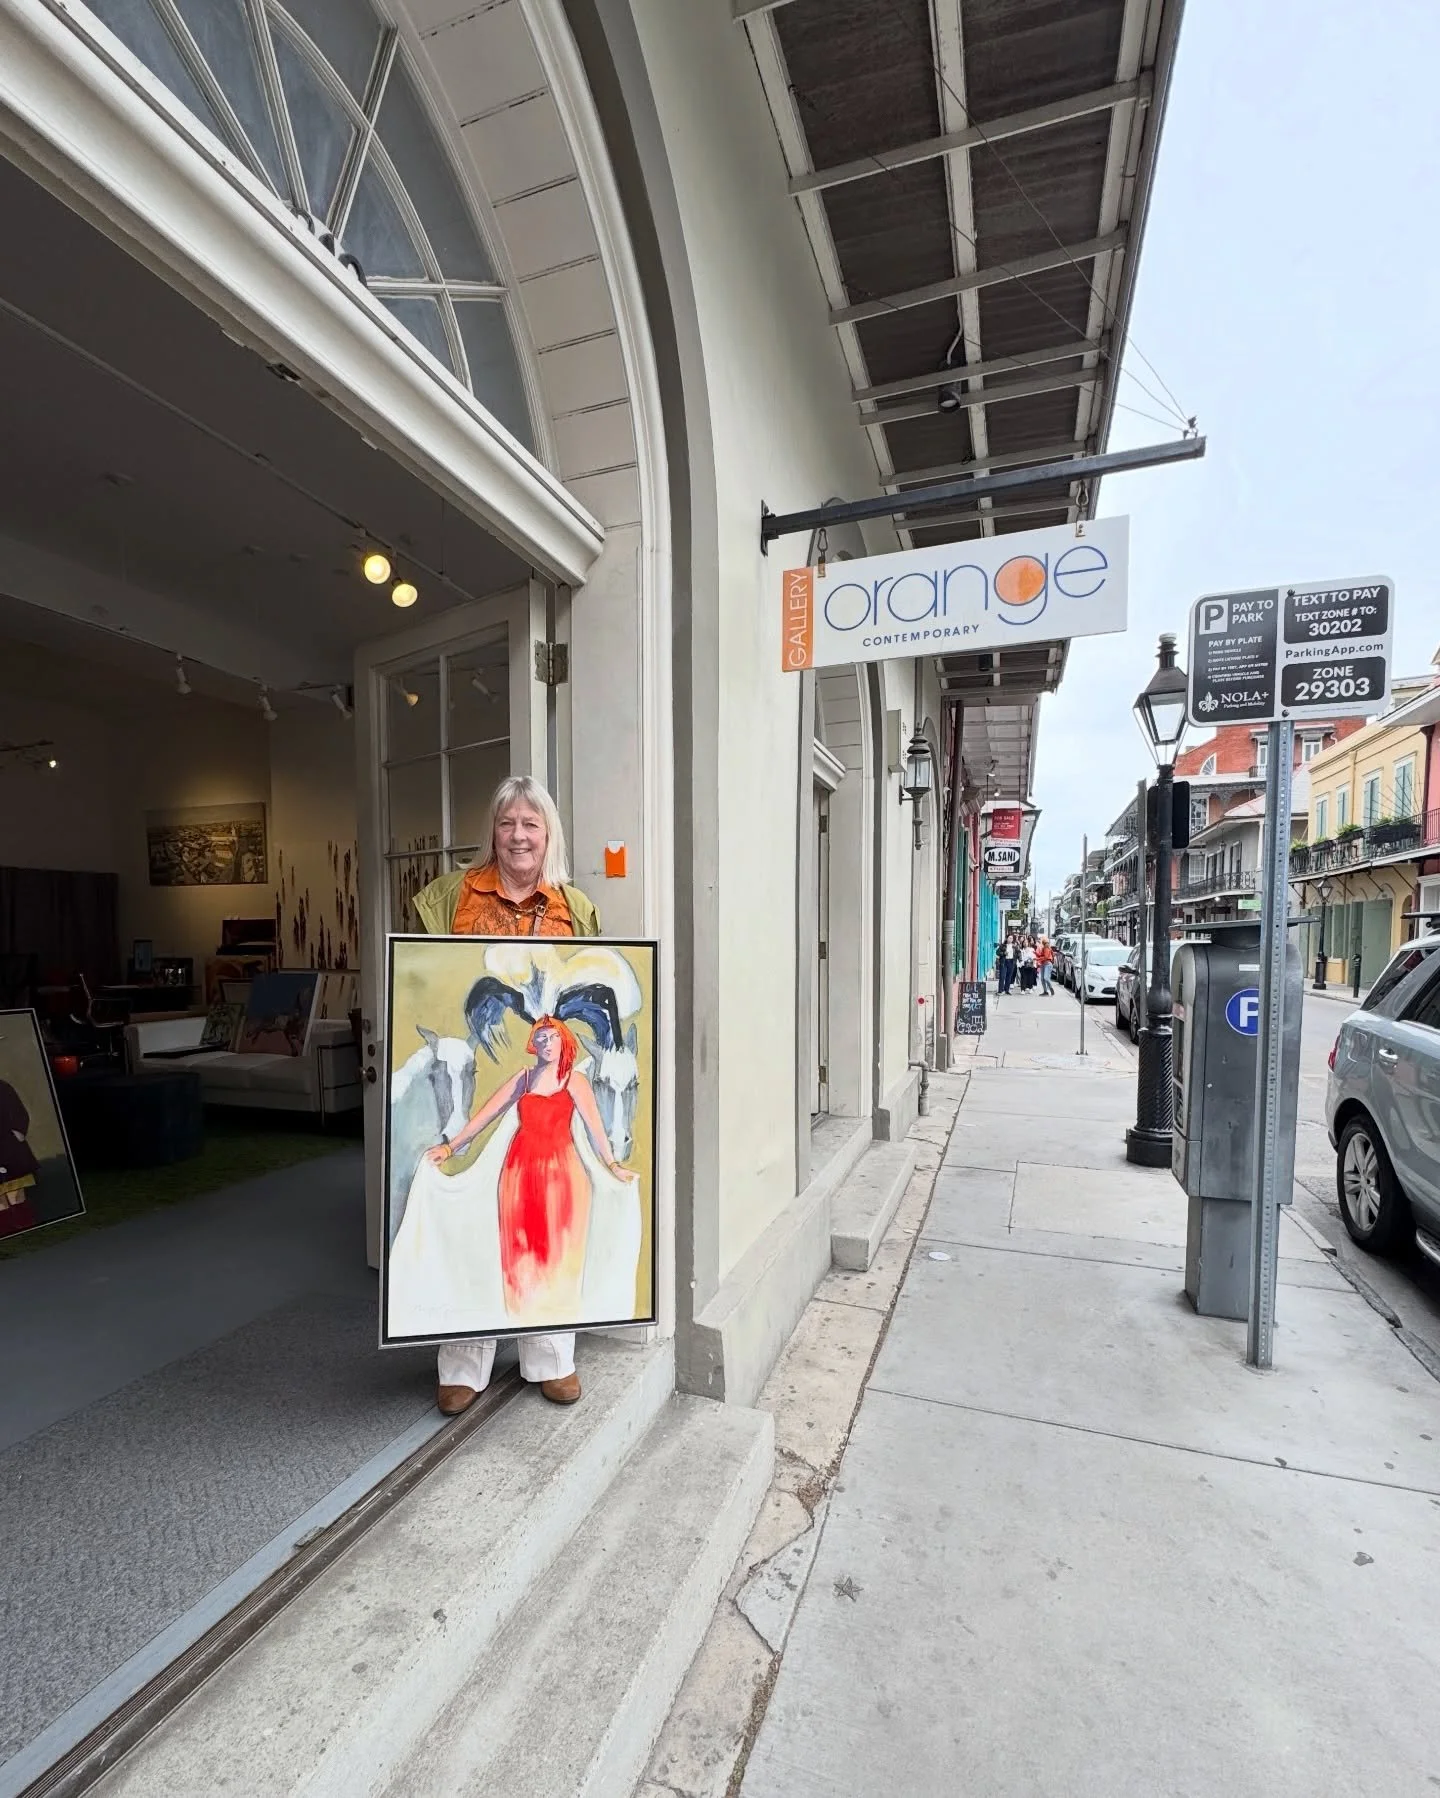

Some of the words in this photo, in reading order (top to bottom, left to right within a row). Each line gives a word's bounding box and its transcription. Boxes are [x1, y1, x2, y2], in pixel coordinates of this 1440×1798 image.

[824, 545, 1108, 631] orange
[1293, 593, 1328, 607] TEXT
[1330, 591, 1349, 603] TO
[1352, 587, 1381, 600] PAY
[1232, 602, 1254, 613] PAY
[1257, 599, 1274, 610] TO
[1295, 612, 1321, 623] TEXT
[1321, 608, 1350, 620] ZONE
[1351, 608, 1358, 616] #
[1359, 605, 1377, 615] TO:
[787, 572, 809, 667] GALLERY
[1204, 604, 1225, 631] P
[1232, 612, 1264, 625] PARK
[862, 624, 980, 648] CONTEMPORARY
[1308, 618, 1362, 637] 30202
[1208, 640, 1223, 648] PAY
[1225, 638, 1236, 646] BY
[1238, 636, 1263, 645] PLATE
[1285, 642, 1383, 659] ParkingApp.com
[1312, 665, 1354, 680] ZONE
[1220, 690, 1269, 704] NOLA+
[1294, 677, 1370, 701] 29303
[987, 851, 1016, 862] M.SANI
[1240, 997, 1259, 1027] P
